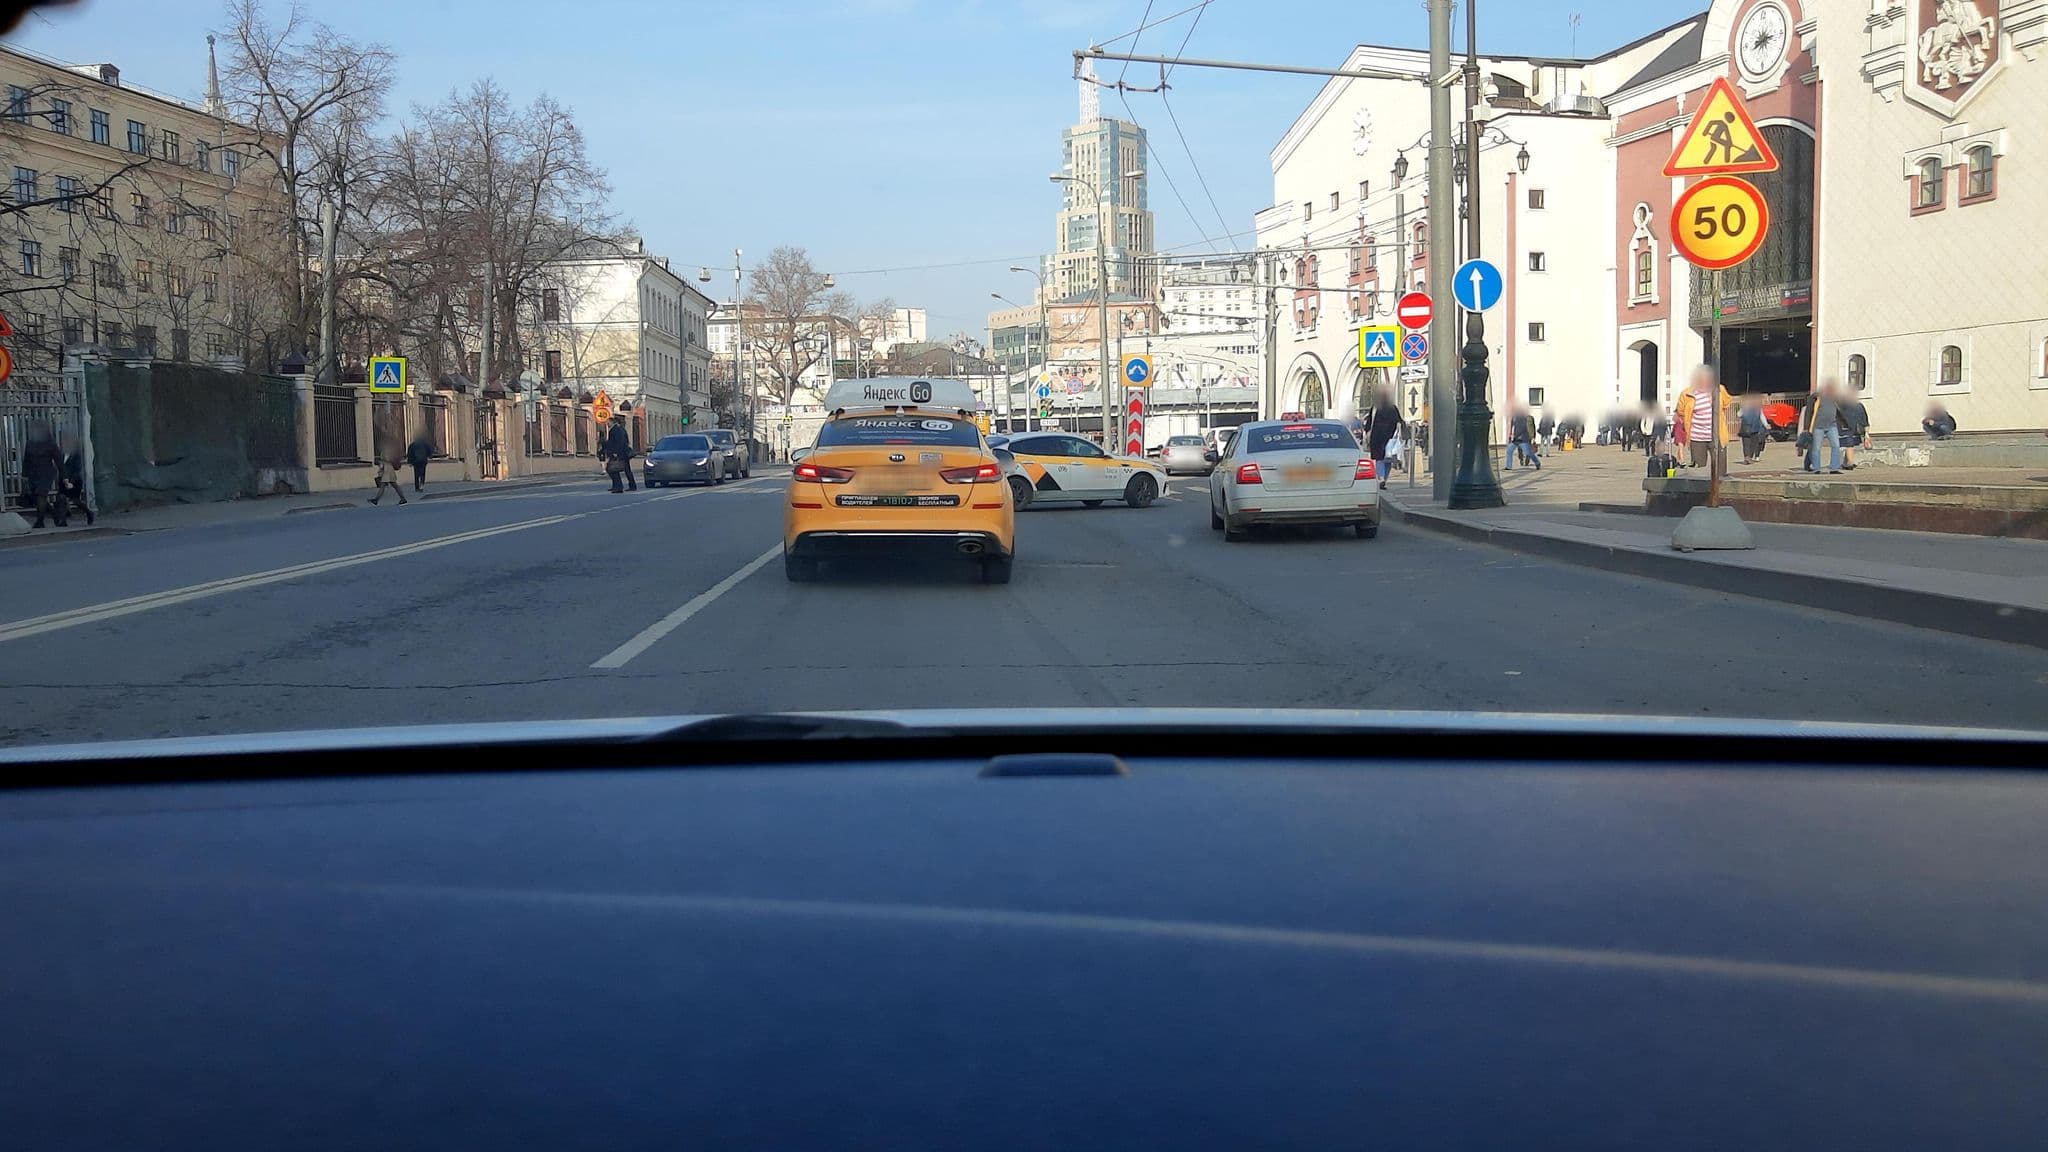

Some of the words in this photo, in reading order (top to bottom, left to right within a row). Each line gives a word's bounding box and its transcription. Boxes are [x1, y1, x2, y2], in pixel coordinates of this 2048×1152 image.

[1693, 203, 1746, 240] 50
[863, 385, 907, 402] Яндекс
[912, 384, 929, 400] Go
[854, 419, 918, 428] Яндекс
[926, 420, 948, 429] Go
[1263, 432, 1339, 443] 999-99-99
